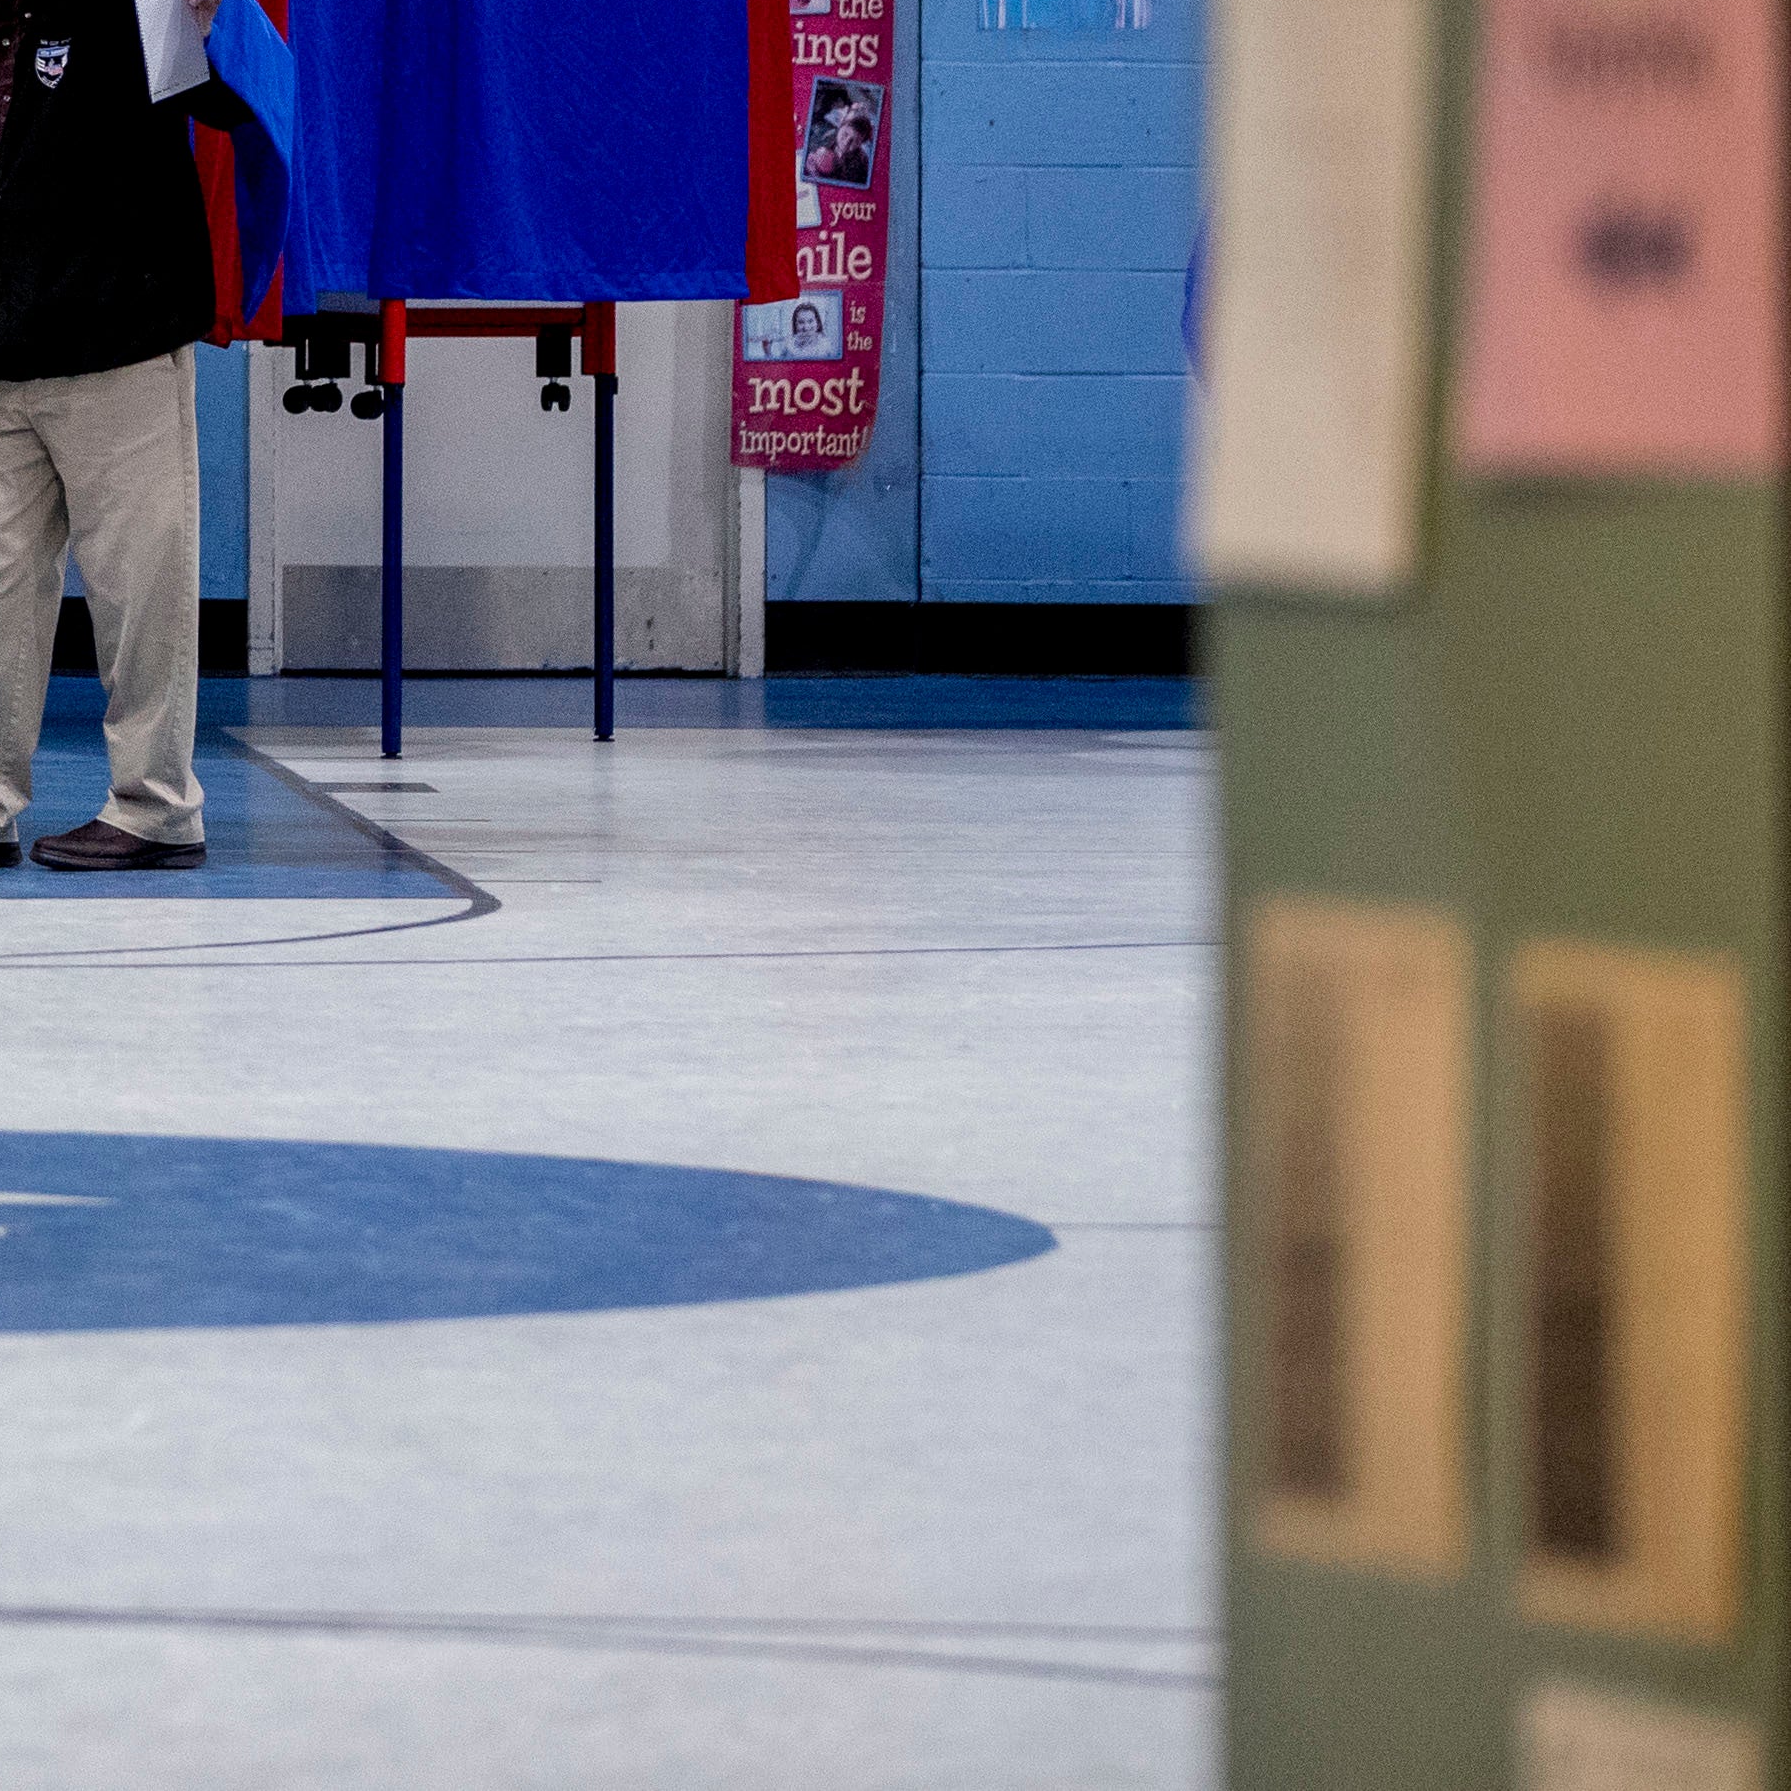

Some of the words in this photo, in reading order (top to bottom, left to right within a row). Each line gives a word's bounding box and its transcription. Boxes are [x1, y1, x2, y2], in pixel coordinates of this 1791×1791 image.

[792, 19, 880, 77] ings
[829, 200, 877, 228] your
[849, 300, 867, 324] is
[846, 330, 873, 351] the
[748, 366, 866, 417] most
[739, 420, 870, 462] important!
